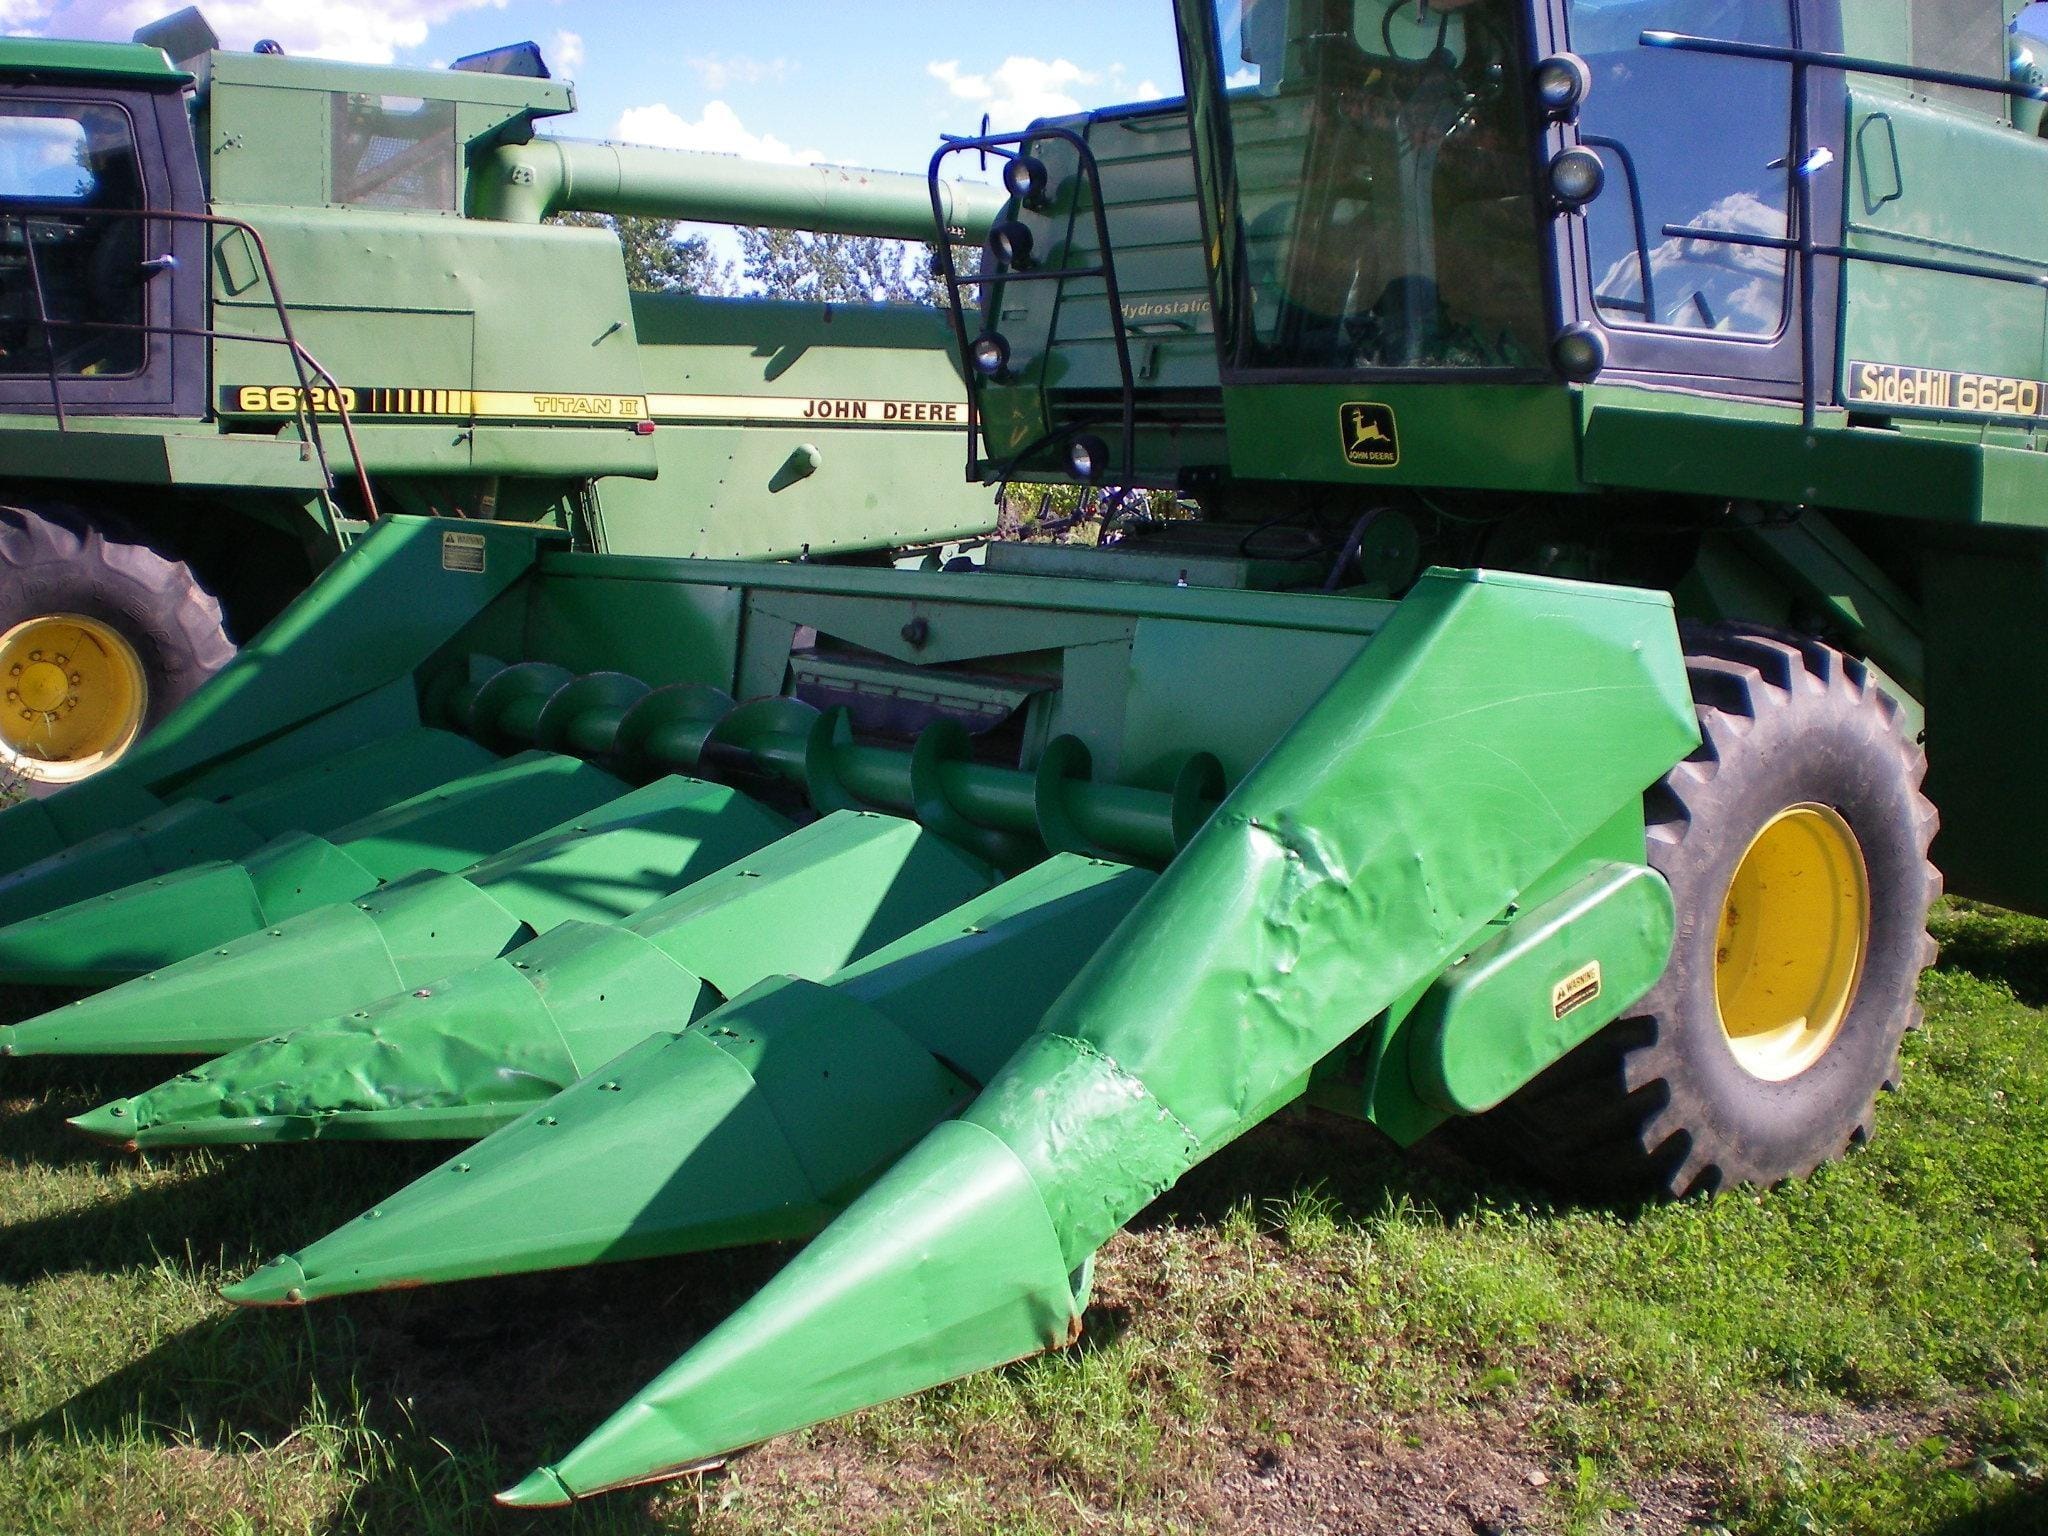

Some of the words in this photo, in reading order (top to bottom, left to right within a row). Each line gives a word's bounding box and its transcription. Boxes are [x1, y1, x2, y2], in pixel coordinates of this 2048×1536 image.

[1121, 300, 1210, 318] Hydrostatic
[1861, 364, 1950, 407] SideHill
[1958, 374, 2037, 414] 6620
[533, 397, 611, 413] TITAN
[803, 400, 867, 418] JOHN
[884, 403, 957, 420] DEERE
[1348, 451, 1368, 460] JOHN
[1369, 452, 1395, 460] DEERE
[1566, 968, 1597, 993] WARNING
